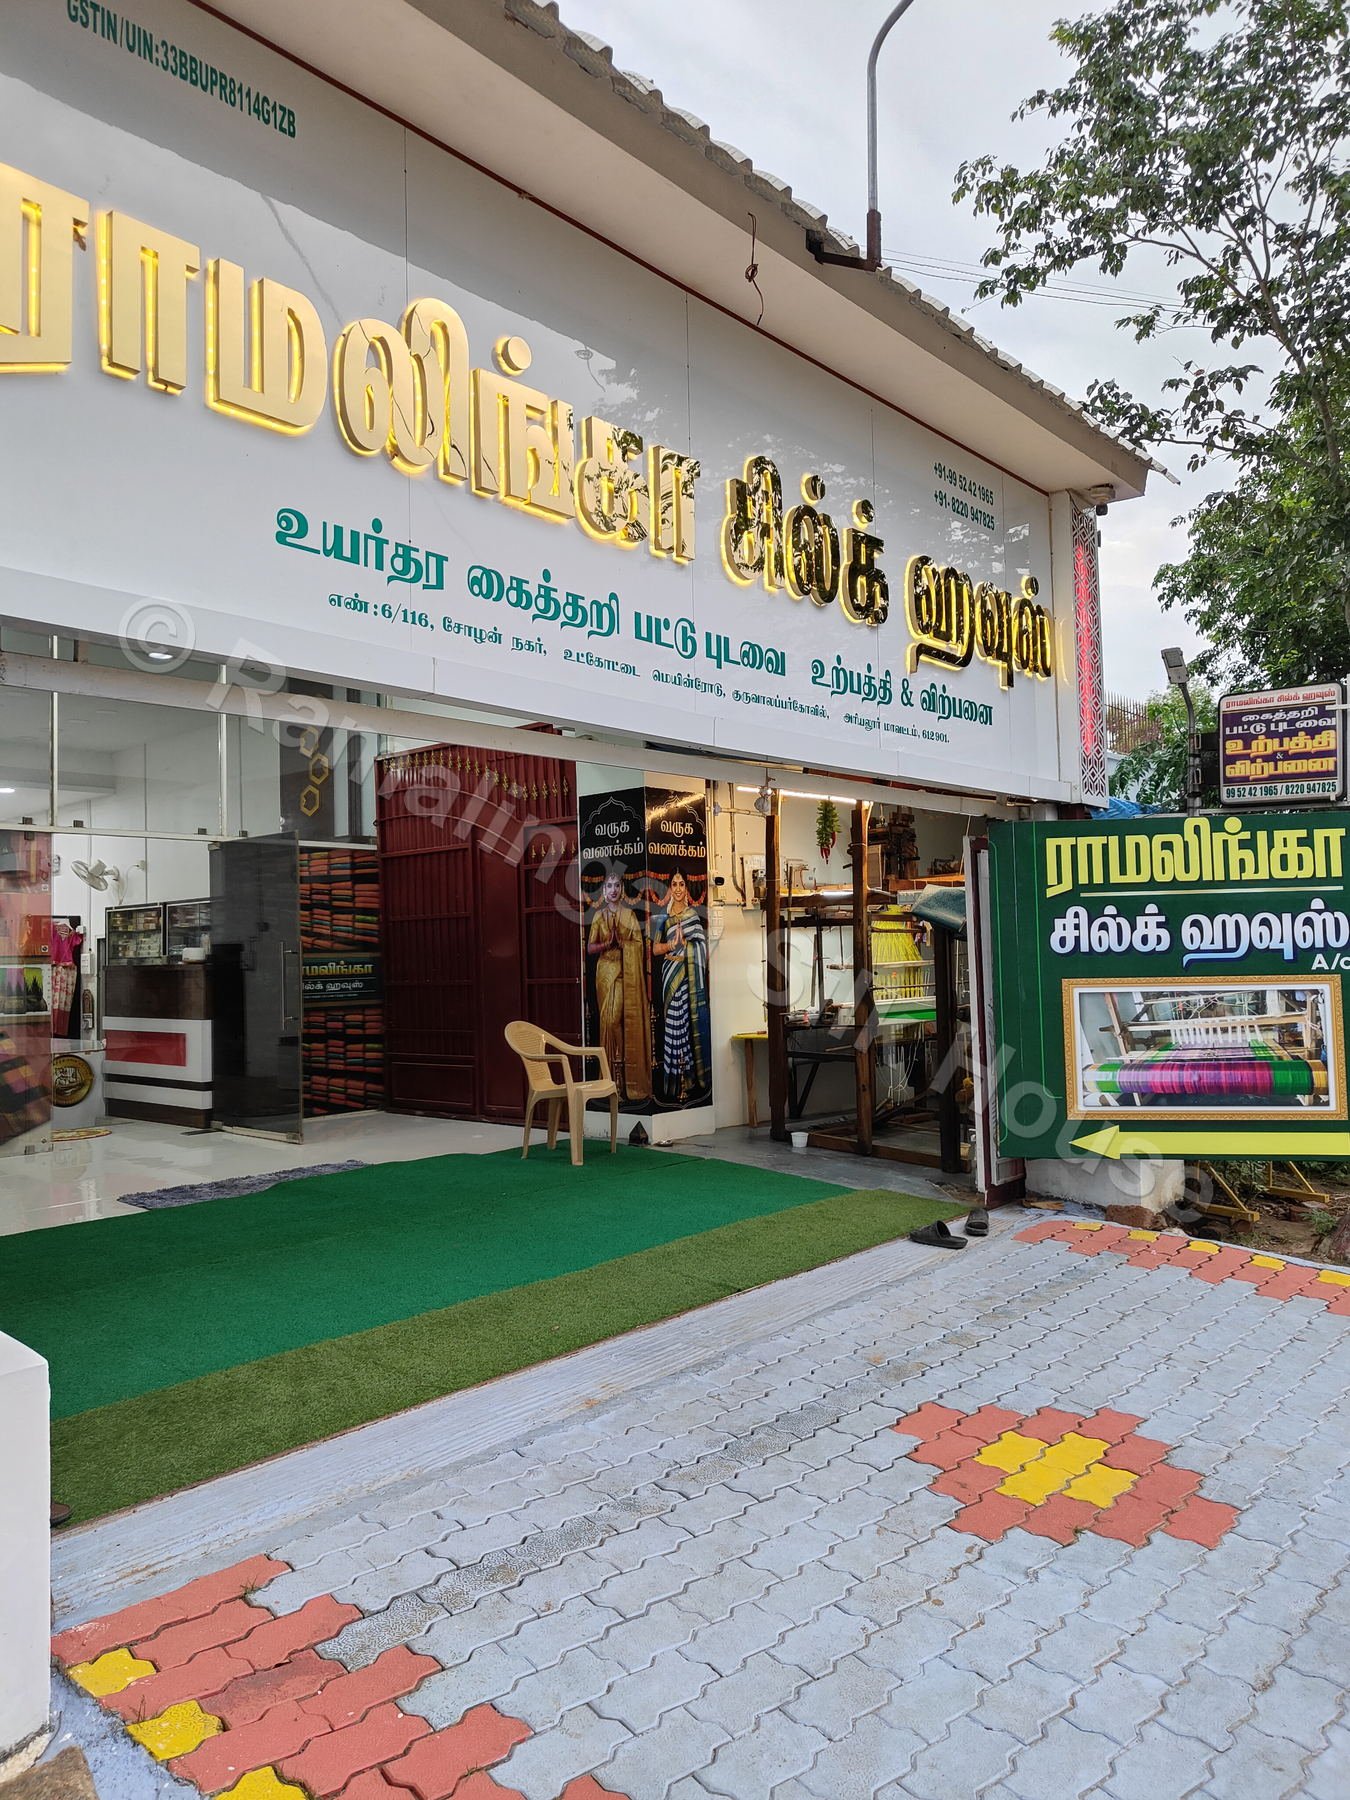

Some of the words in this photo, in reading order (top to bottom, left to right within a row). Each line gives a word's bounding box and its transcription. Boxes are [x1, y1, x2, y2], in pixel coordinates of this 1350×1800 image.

[978, 484, 994, 506] 1965
[970, 505, 995, 531] 947825
[722, 455, 890, 628] சில்க்
[904, 555, 1056, 691] ஹவுஸ்
[275, 507, 449, 591] உயர்தர
[466, 564, 620, 640] கைத்தறி
[633, 610, 698, 660] பட்டு
[705, 631, 786, 677] புடவை
[811, 655, 893, 707] உற்பத்தி
[900, 678, 914, 707] &
[920, 682, 994, 726] விற்பனை
[442, 616, 502, 645] சோழன்
[511, 637, 547, 657] நகர்,
[563, 648, 641, 677] உட்கோட்டை
[1226, 696, 1275, 709] ராமலிங்கா
[1241, 706, 1319, 722] கைத்தறி
[1225, 722, 1267, 735] பட்டு
[1270, 717, 1336, 733] புடவை
[1225, 730, 1337, 758] உற்பத்தி
[1275, 752, 1284, 760] &
[1225, 757, 1337, 781] விற்பனை
[1226, 788, 1236, 798] 99
[1237, 786, 1246, 798] 52
[1248, 786, 1258, 797] 42
[1260, 785, 1278, 797] 1965
[1285, 783, 1305, 795] 8220
[1306, 781, 1337, 794] 947825
[595, 820, 630, 838] வருக
[660, 820, 694, 838] வருக
[582, 836, 644, 859] வணக்கம்
[648, 839, 706, 858] வணக்கம்
[1046, 816, 1346, 899] ராமலிங்கா
[1050, 903, 1171, 953] சில்க்
[1181, 897, 1350, 969] ஹவுஸ்
